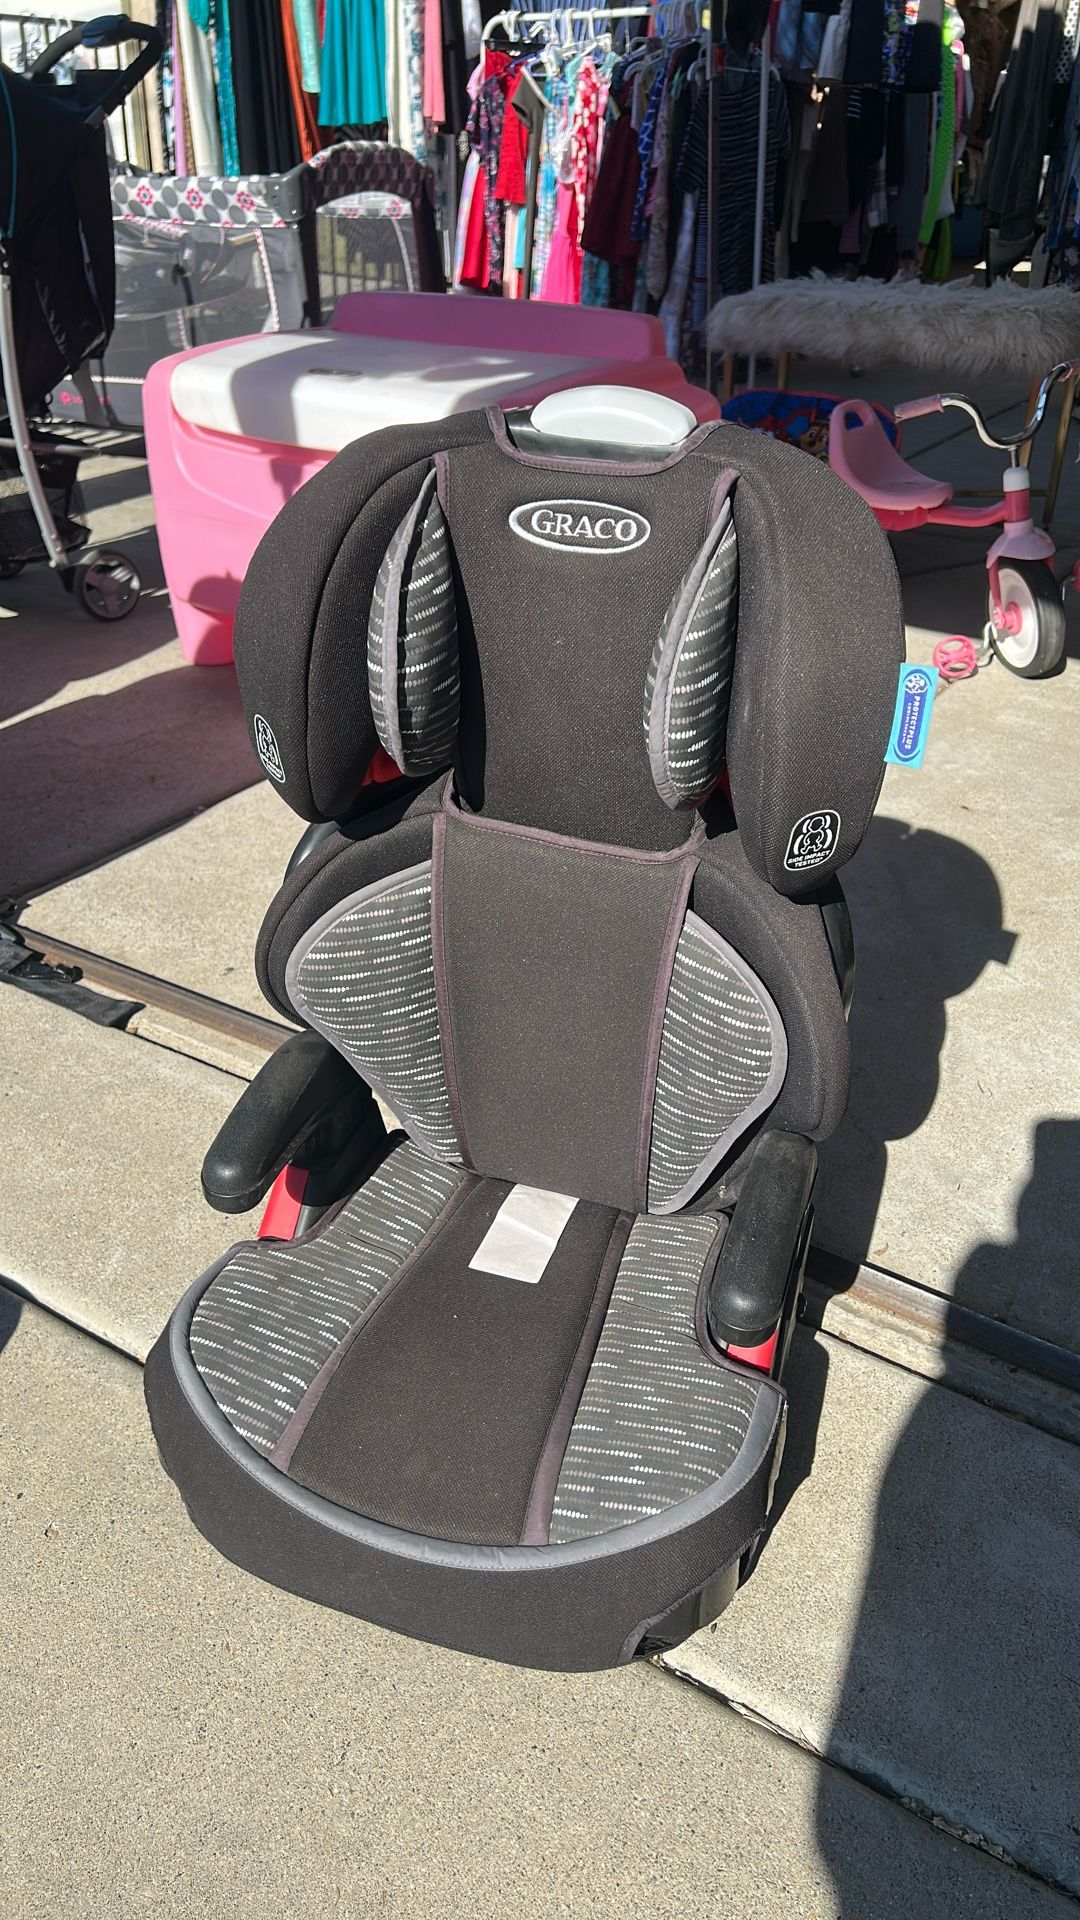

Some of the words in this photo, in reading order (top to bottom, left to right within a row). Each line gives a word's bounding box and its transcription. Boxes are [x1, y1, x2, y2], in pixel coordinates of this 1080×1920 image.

[531, 509, 638, 541] GRACO
[787, 856, 804, 864] SIDE
[804, 850, 831, 860] IMPACT
